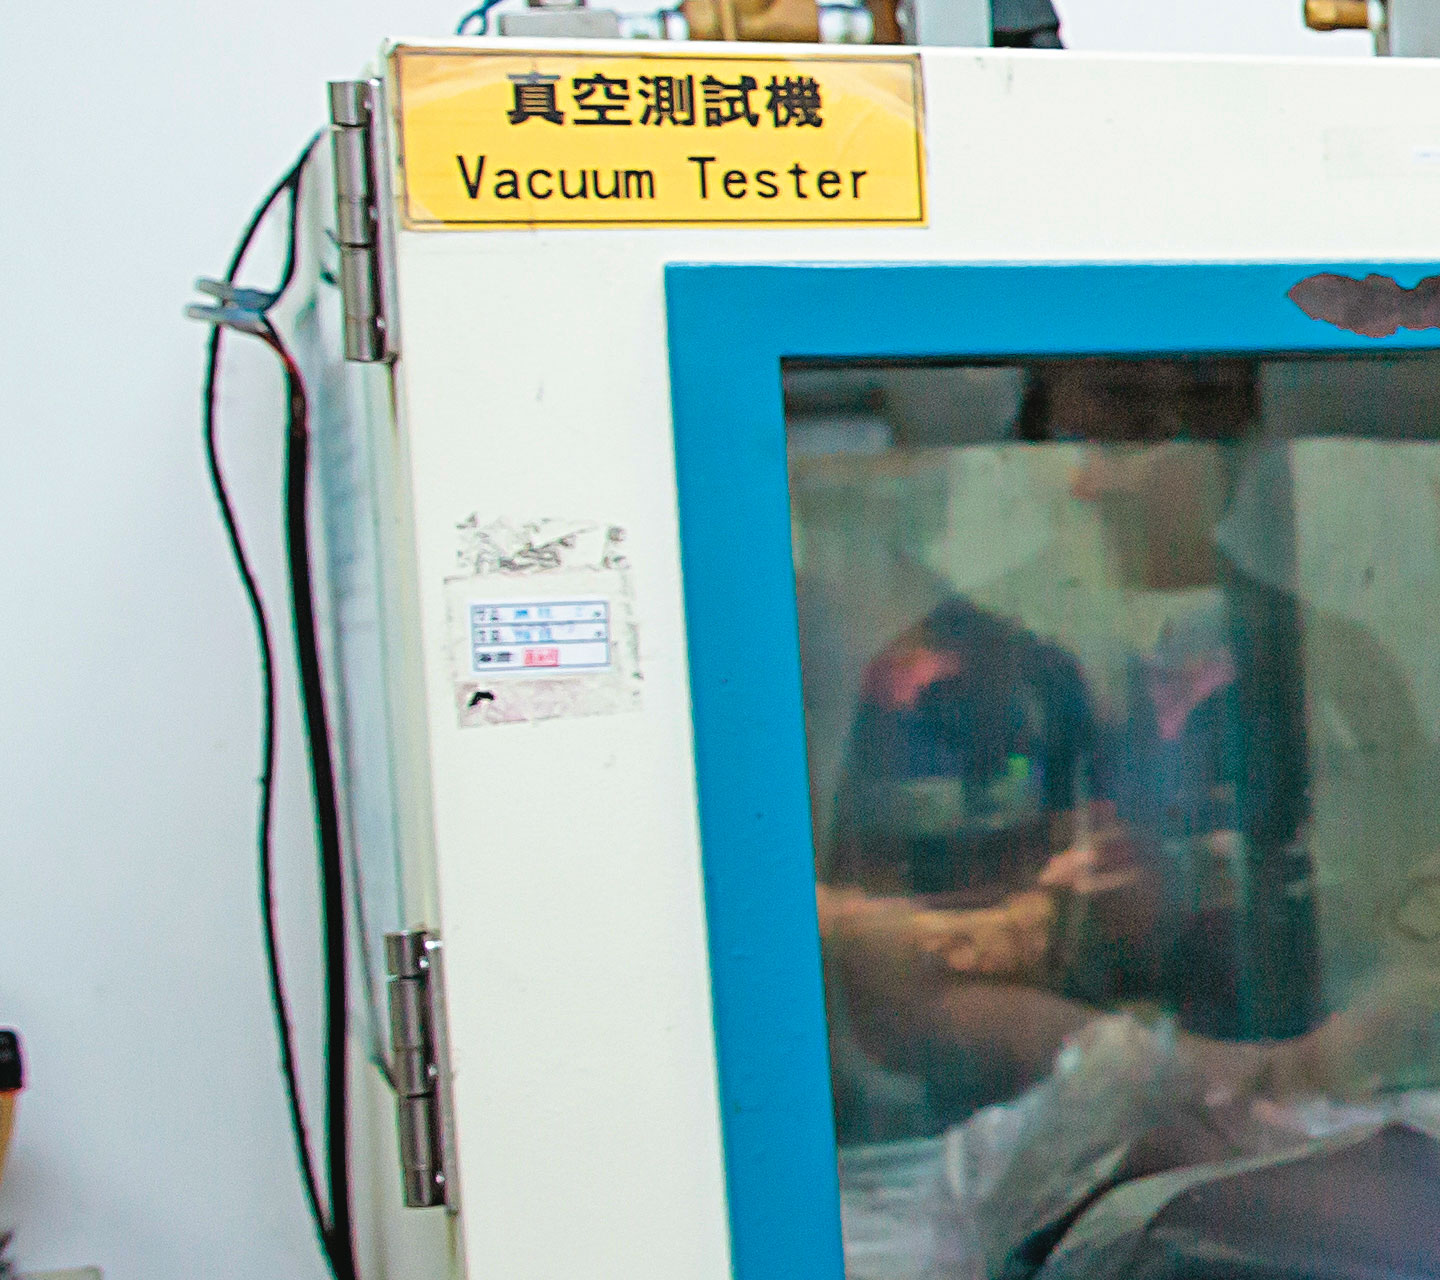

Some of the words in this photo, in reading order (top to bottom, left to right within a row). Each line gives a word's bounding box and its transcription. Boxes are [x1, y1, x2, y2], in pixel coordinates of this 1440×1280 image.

[504, 71, 825, 129] 真空測試機
[456, 154, 655, 200] Vacuum
[687, 156, 868, 200] Tester
